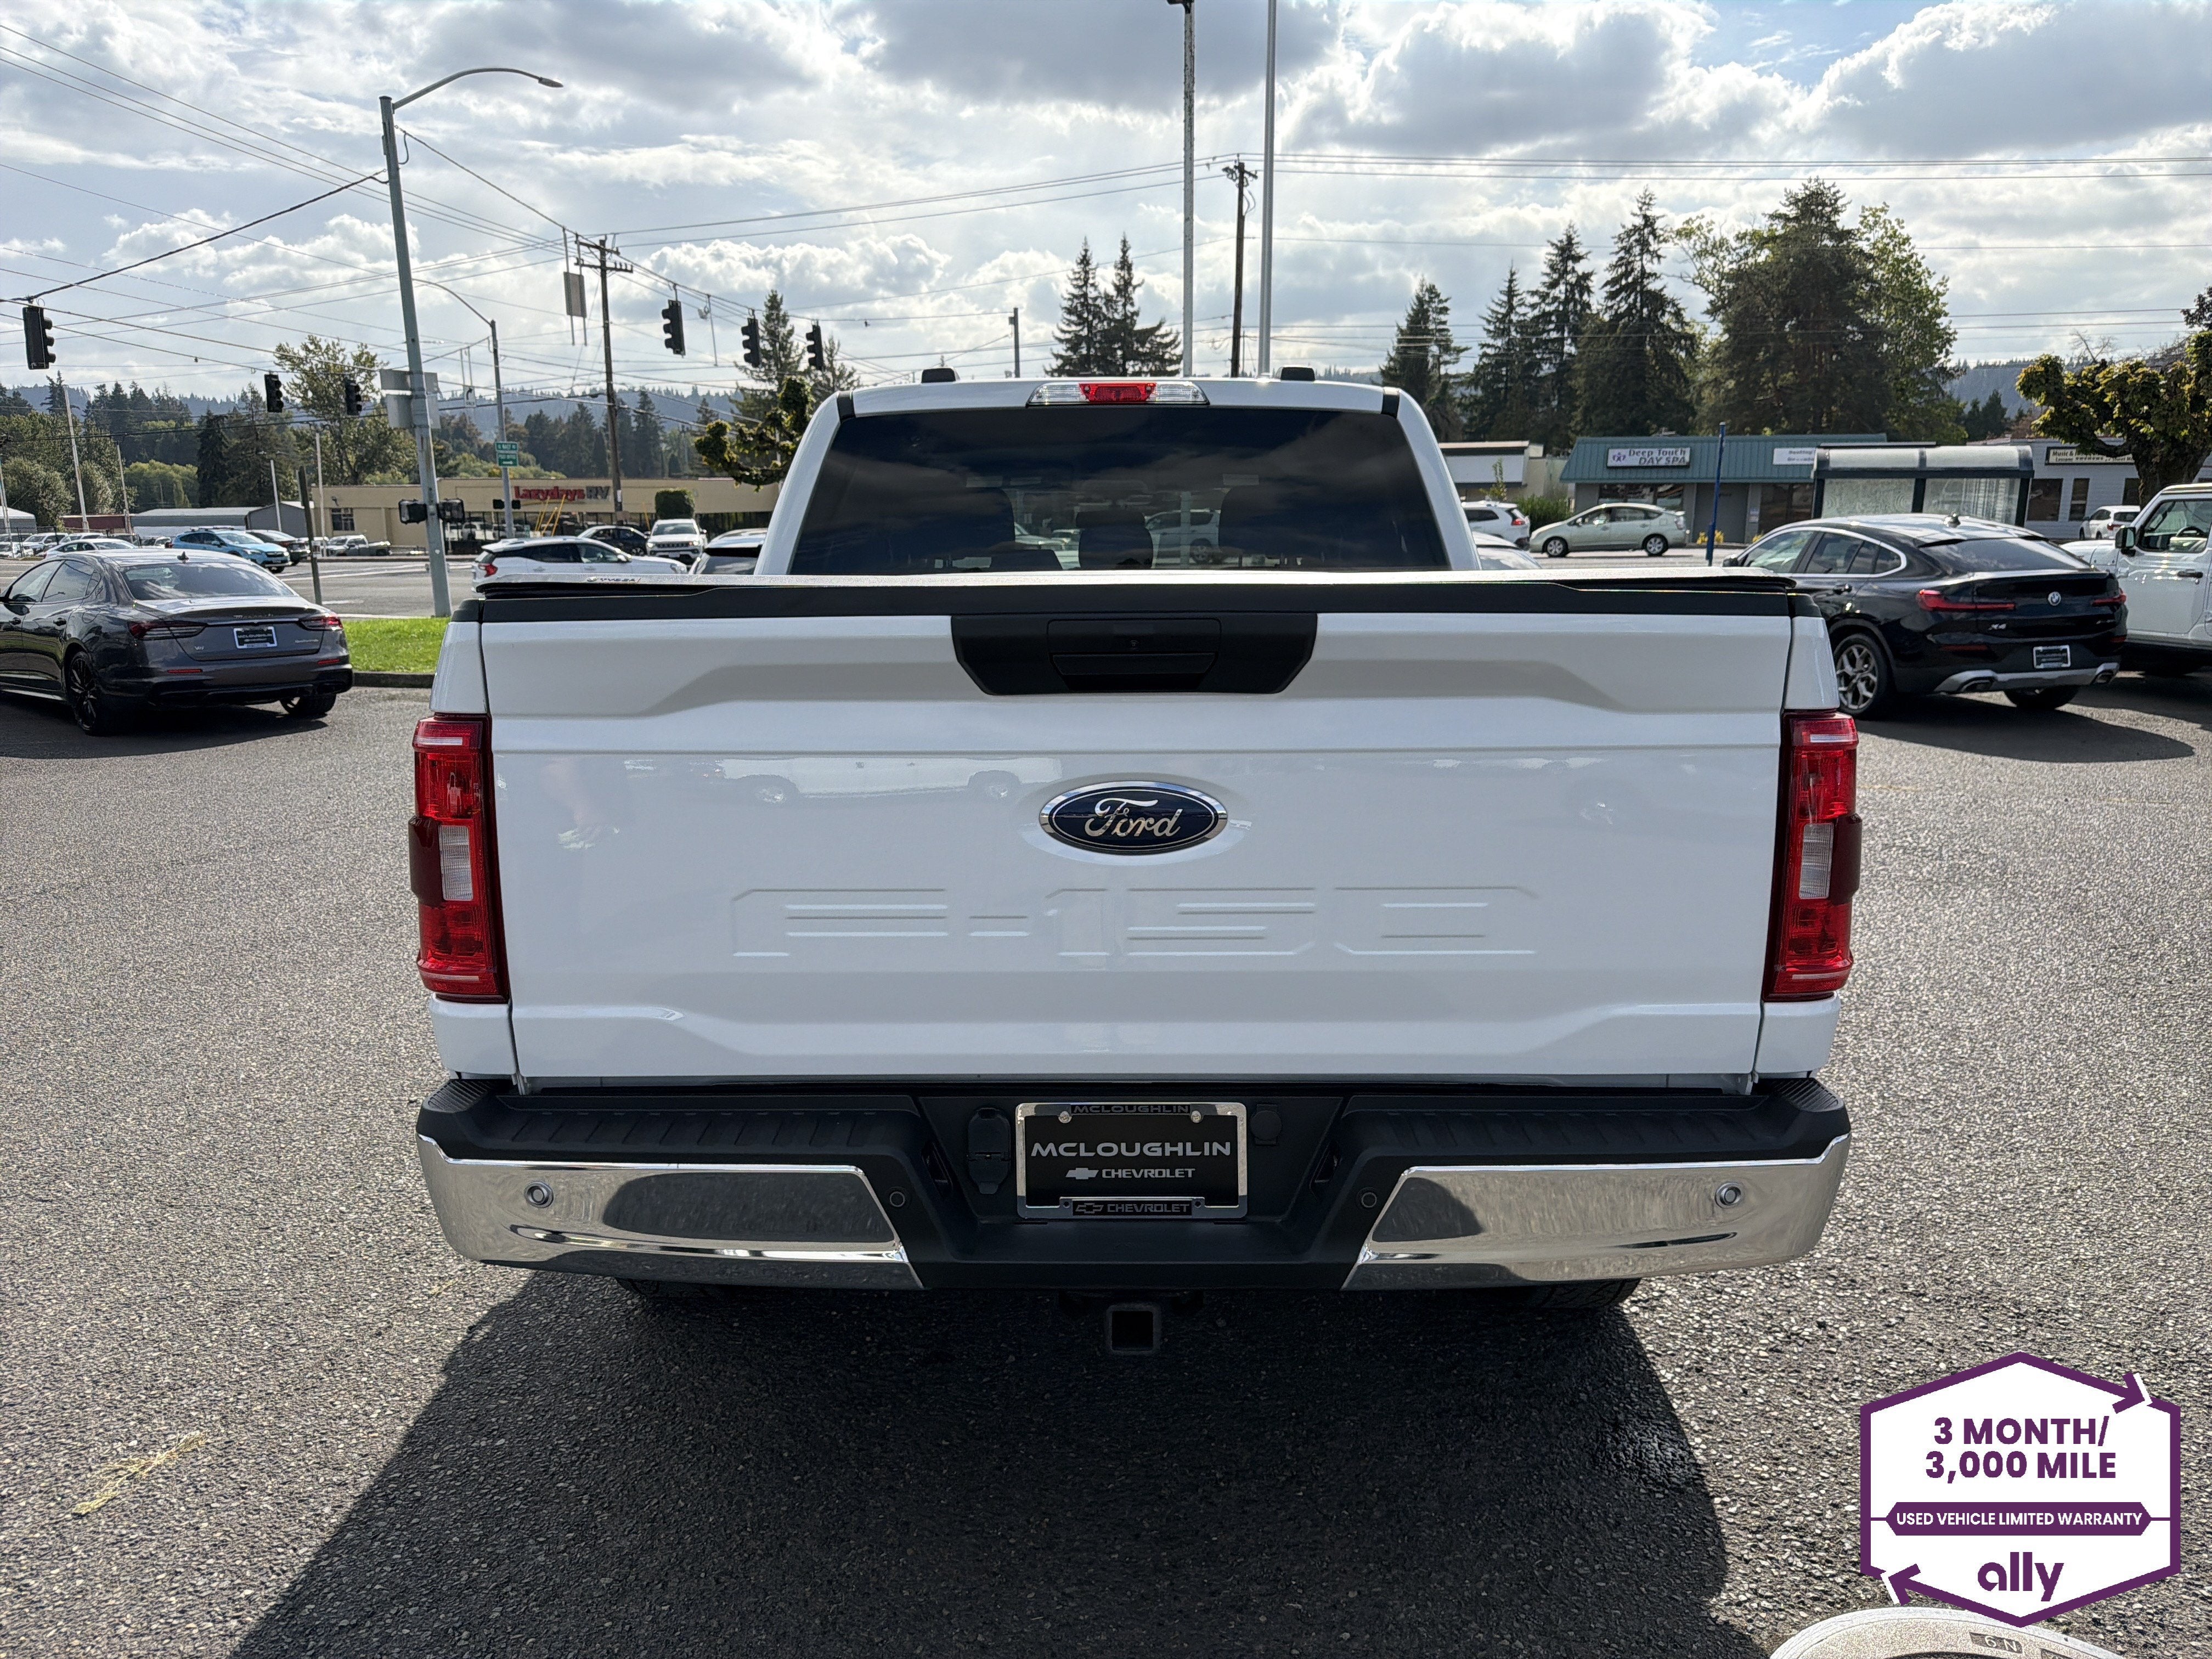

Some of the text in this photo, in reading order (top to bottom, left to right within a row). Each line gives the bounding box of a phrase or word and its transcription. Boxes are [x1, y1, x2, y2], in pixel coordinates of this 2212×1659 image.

[1629, 447, 1686, 458] Deep Touch
[1638, 456, 1686, 465] DAY SPA
[514, 486, 611, 501] Lazydays RV
[1085, 798, 1183, 837] Ford
[731, 885, 1536, 958] F-150
[1073, 1105, 1189, 1114] MCLOUGHLIN
[1030, 1142, 1231, 1157] MCLOUGHLIN
[1102, 1168, 1196, 1178] CHEVROLET
[1107, 1203, 1190, 1213] CHEVROLET
